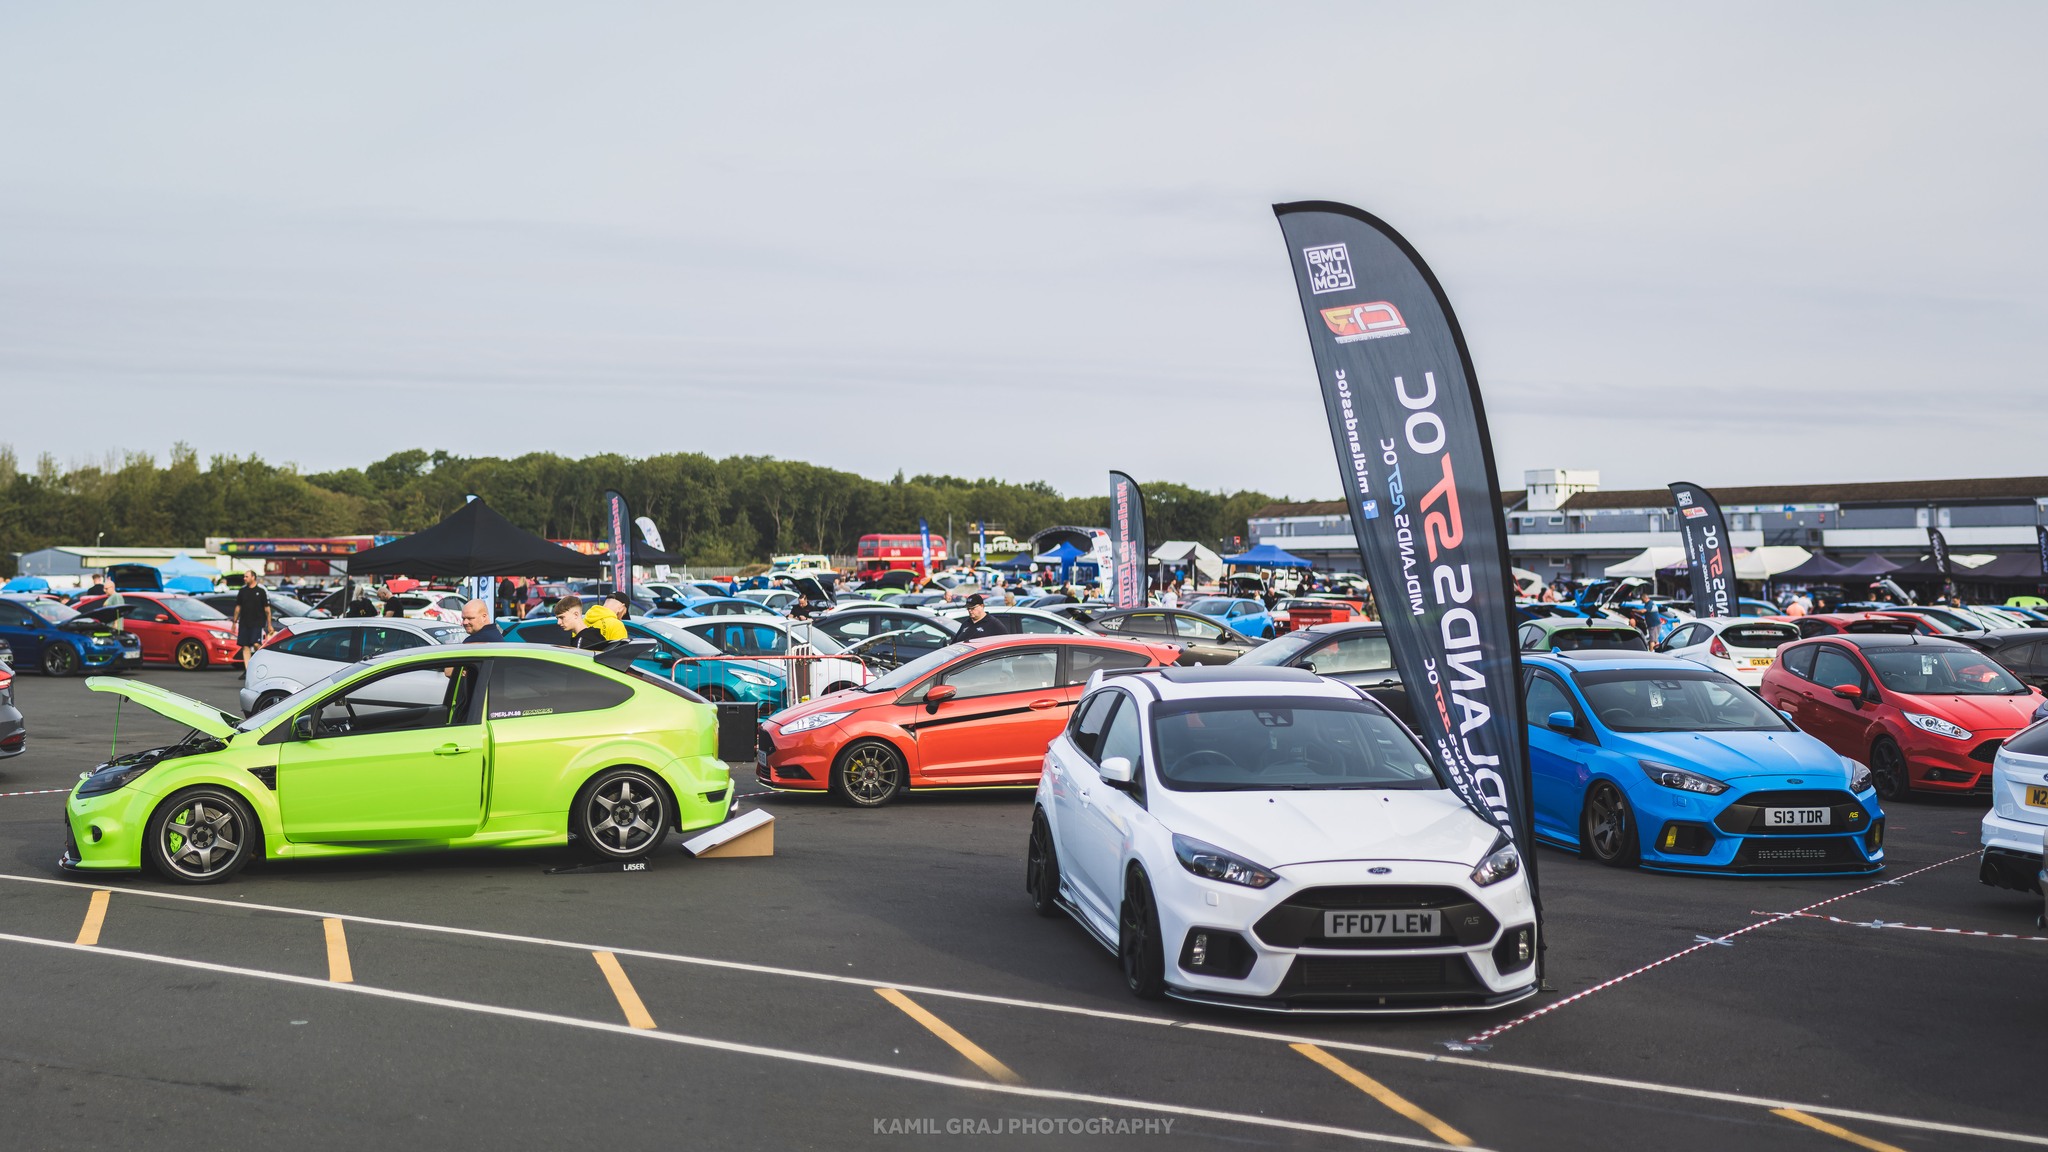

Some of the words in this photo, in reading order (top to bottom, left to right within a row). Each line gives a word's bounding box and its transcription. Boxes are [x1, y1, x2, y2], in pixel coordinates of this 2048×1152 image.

[1774, 810, 1795, 824] S13
[1798, 810, 1823, 823] TDR
[1758, 848, 1826, 859] mountune
[623, 863, 646, 871] LASER
[1332, 914, 1387, 934] FF07
[1392, 913, 1432, 933] LEW
[1464, 916, 1480, 926] RS
